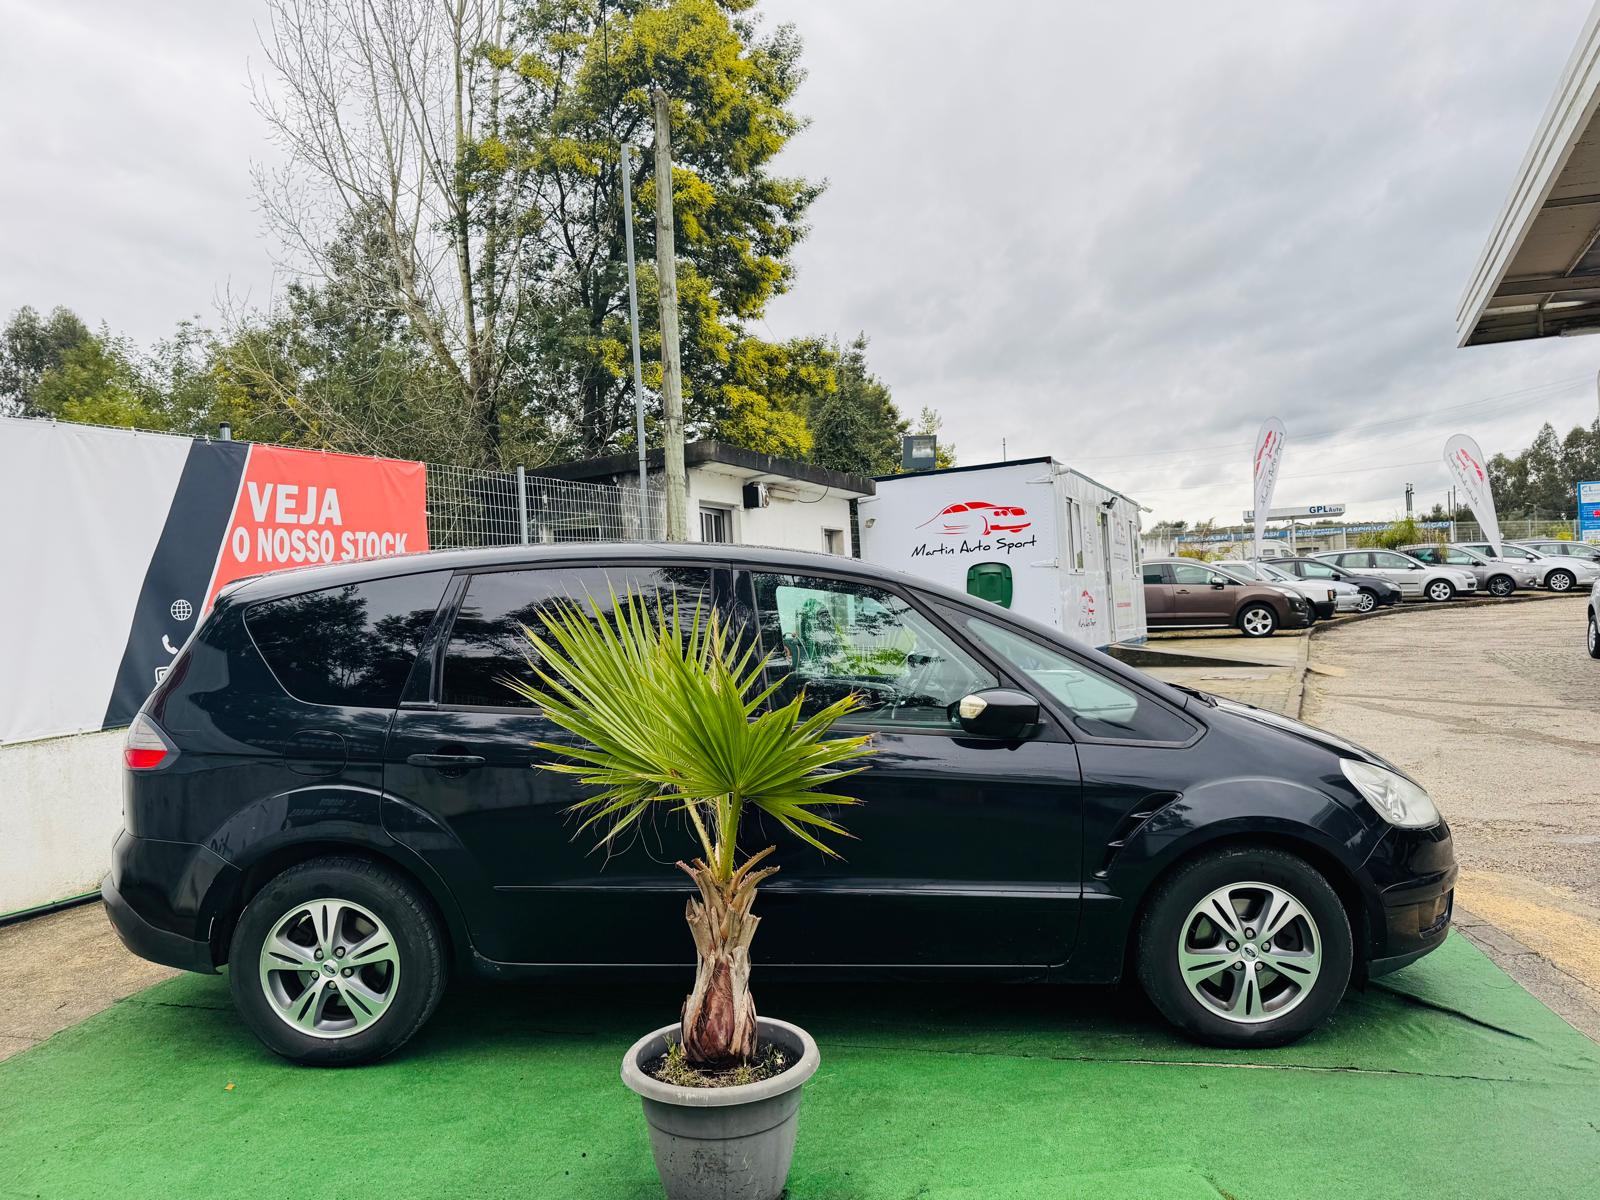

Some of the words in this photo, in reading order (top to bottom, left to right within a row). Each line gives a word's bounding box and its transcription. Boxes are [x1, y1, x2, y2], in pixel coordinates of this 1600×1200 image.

[247, 481, 342, 525] VEJA
[1309, 506, 1328, 514] GPL
[232, 527, 249, 562] O
[258, 528, 334, 562] NOSSO
[341, 531, 408, 560] STOCK
[912, 543, 954, 557] Martin
[959, 540, 991, 554] Auto
[996, 534, 1037, 554] Sport
